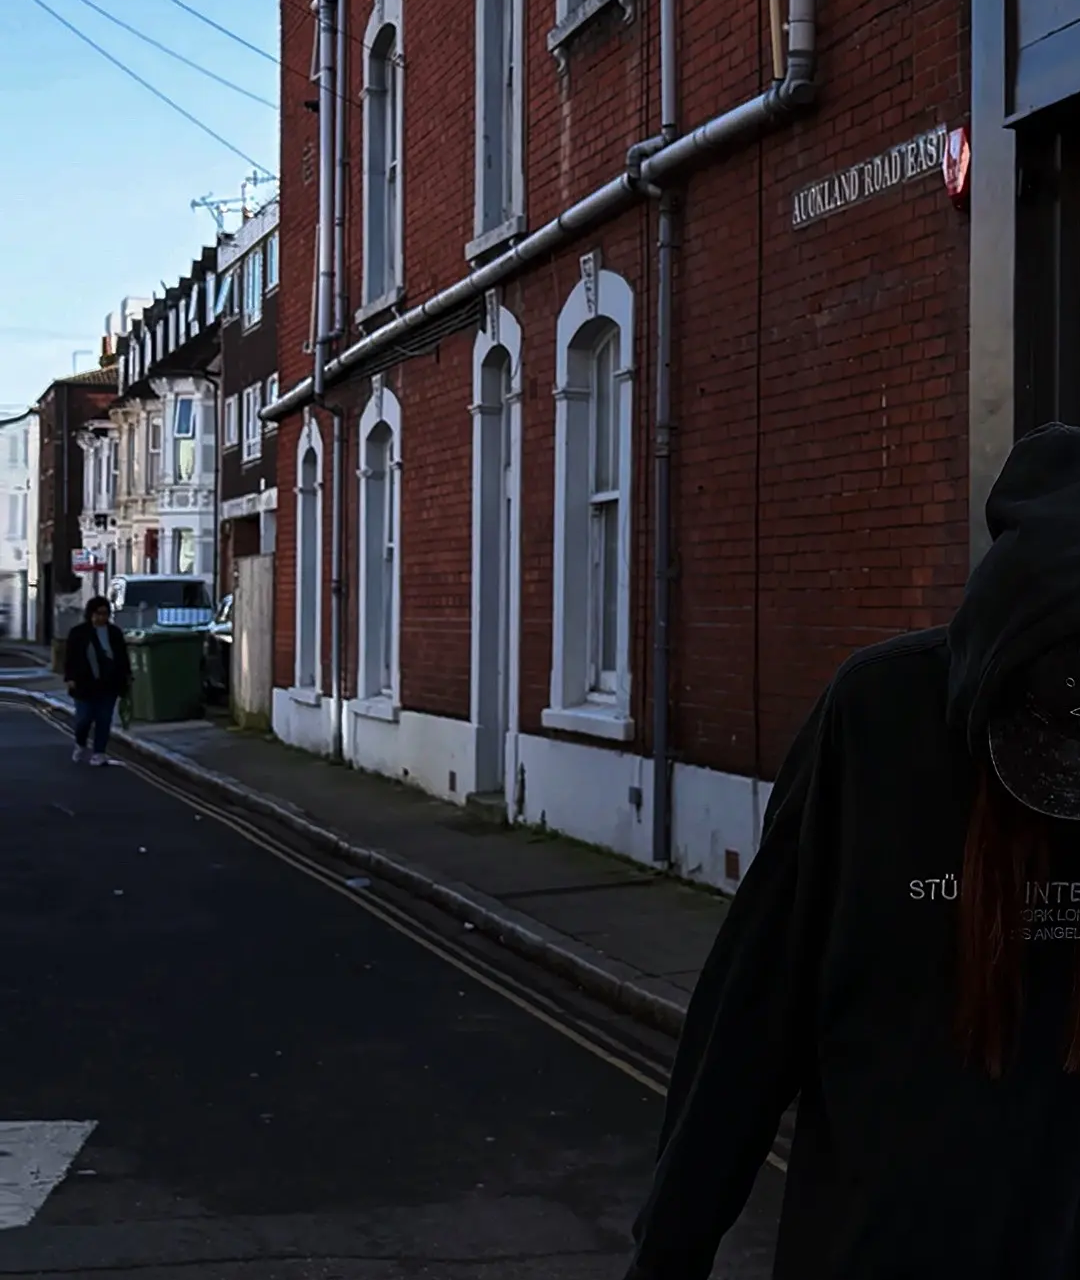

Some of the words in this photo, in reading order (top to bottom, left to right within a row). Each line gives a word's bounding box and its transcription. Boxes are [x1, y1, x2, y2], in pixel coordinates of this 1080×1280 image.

[792, 168, 859, 224] AUCKLAND
[864, 148, 901, 196] ROAD
[906, 129, 947, 178] EAST
[909, 874, 958, 901] STÜ
[1020, 908, 1054, 922] ORK
